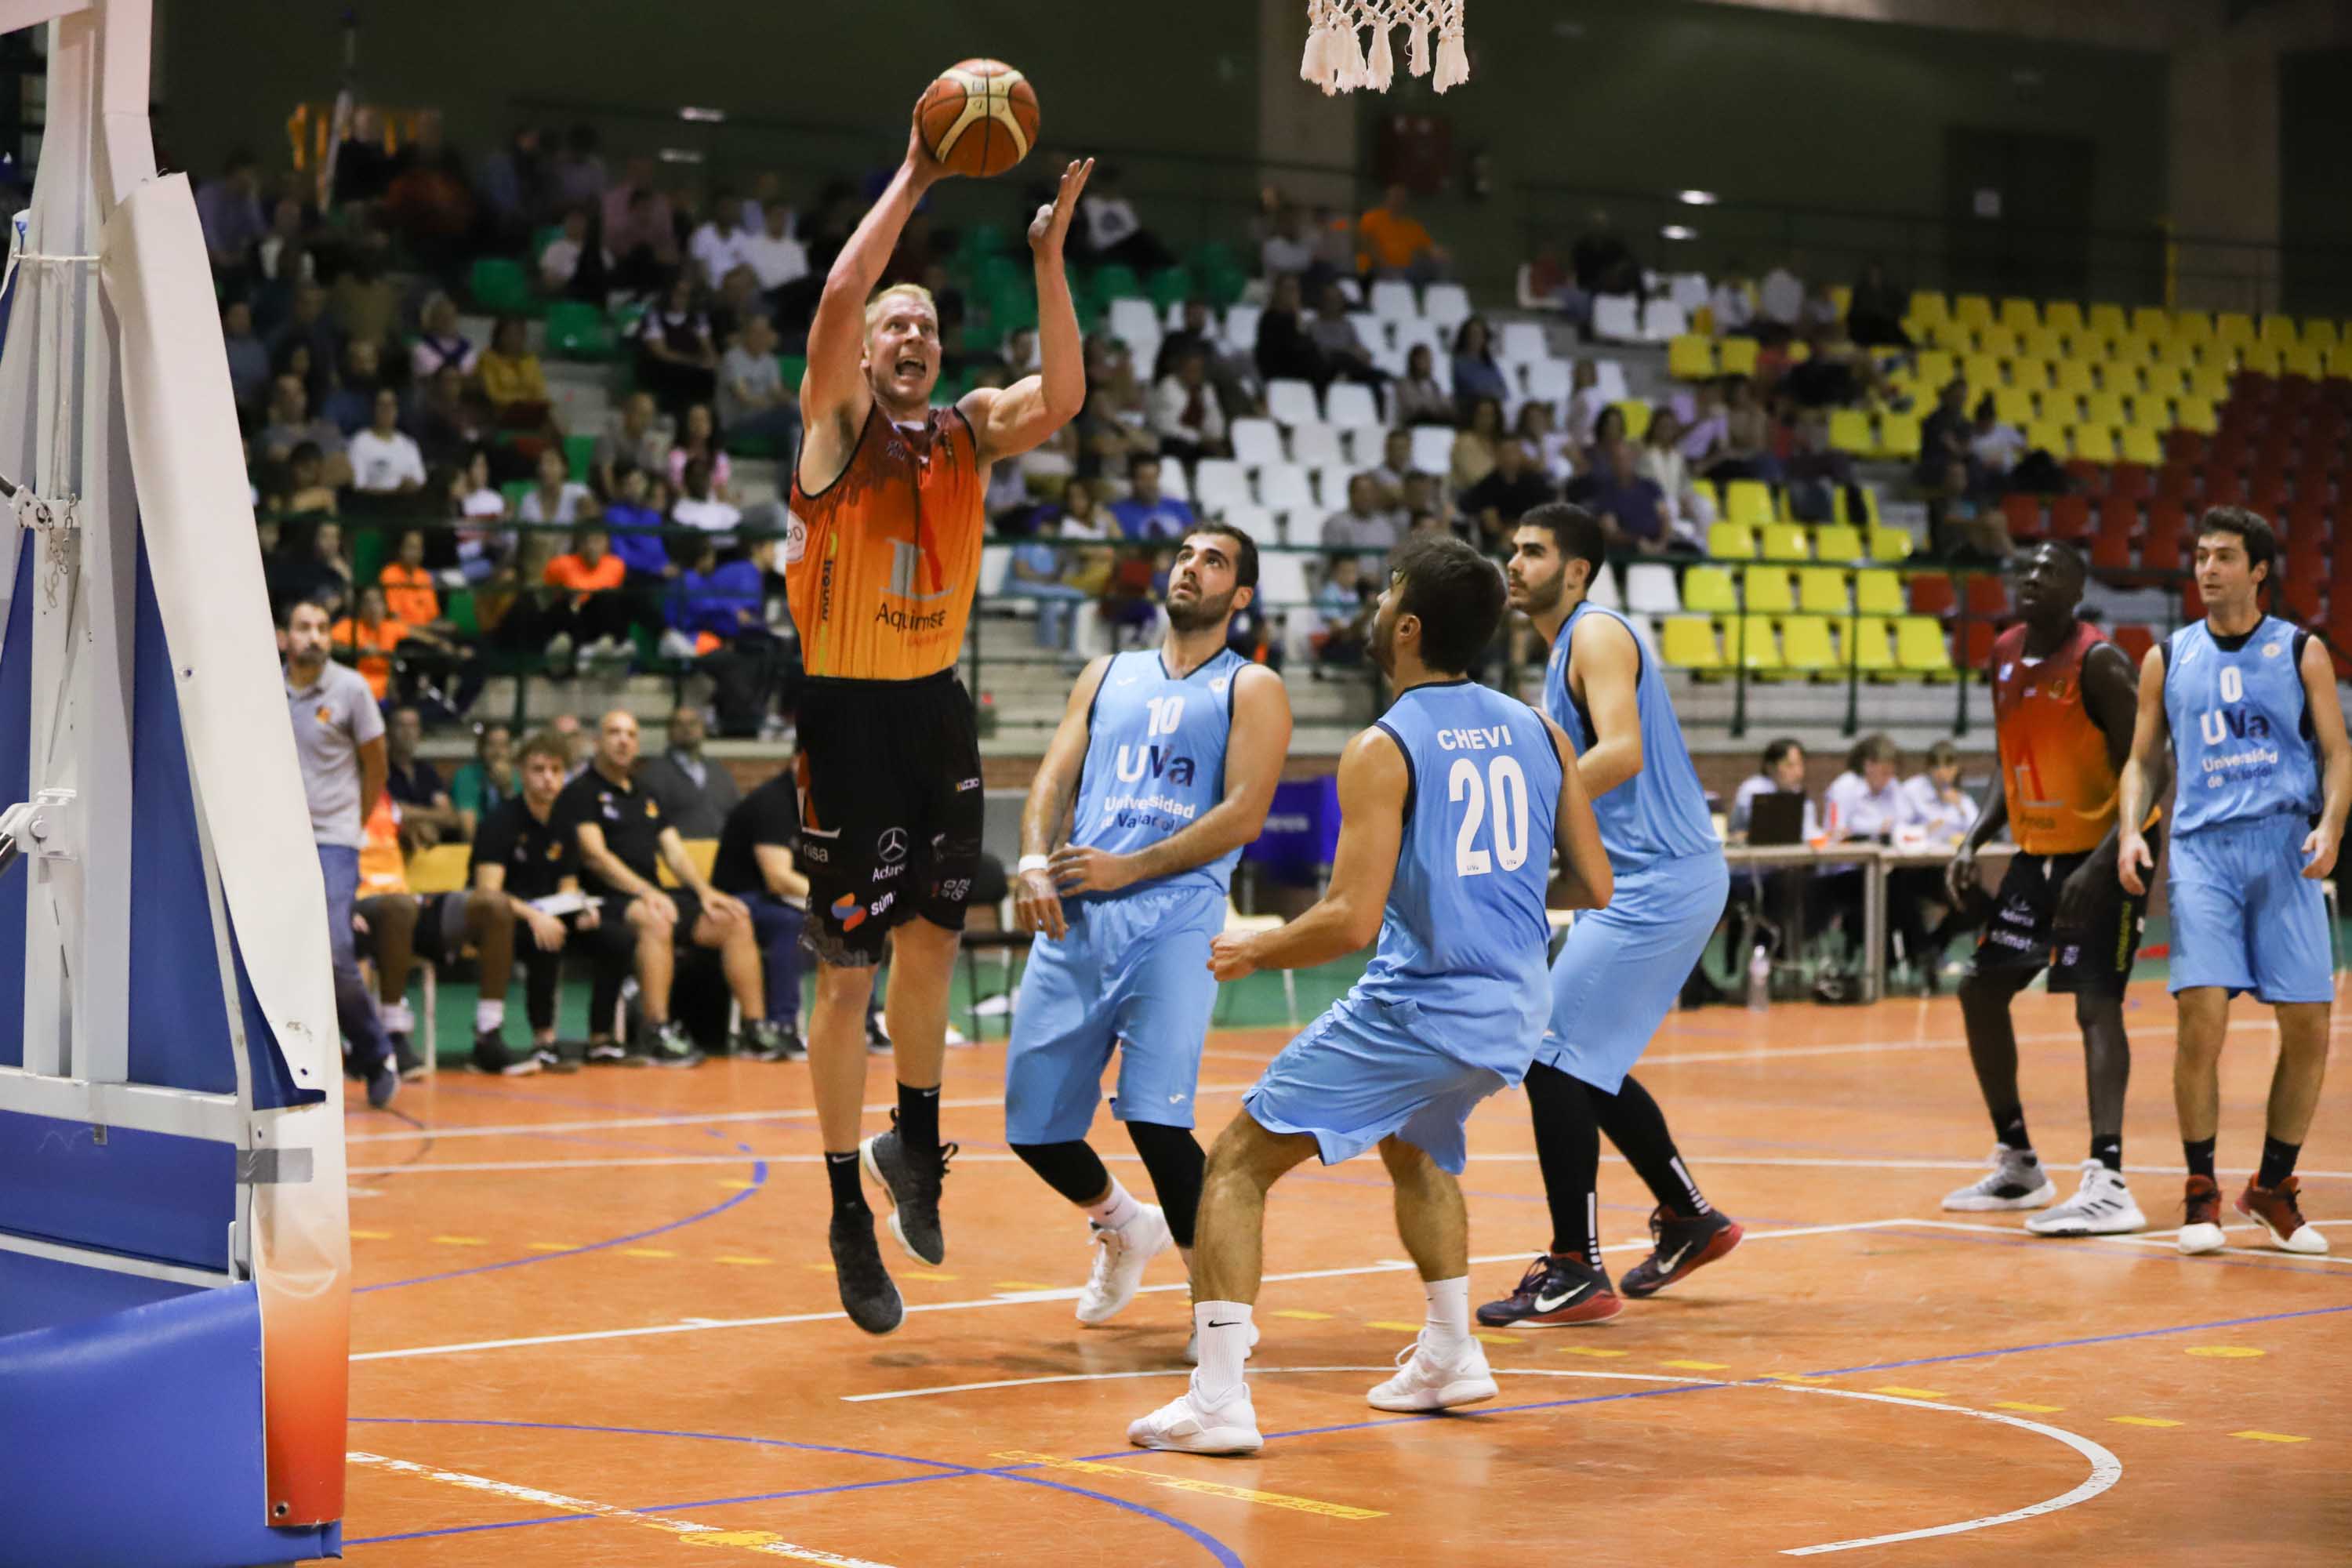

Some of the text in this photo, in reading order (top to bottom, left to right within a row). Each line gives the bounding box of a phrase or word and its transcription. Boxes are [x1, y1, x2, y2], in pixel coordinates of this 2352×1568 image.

[2220, 665, 2243, 703] 0
[1145, 695, 1185, 737] 10
[2200, 708, 2270, 746] UVa
[1436, 724, 1512, 750] CHEVI
[1116, 745, 1196, 787] UVa
[1448, 755, 1529, 877] 20
